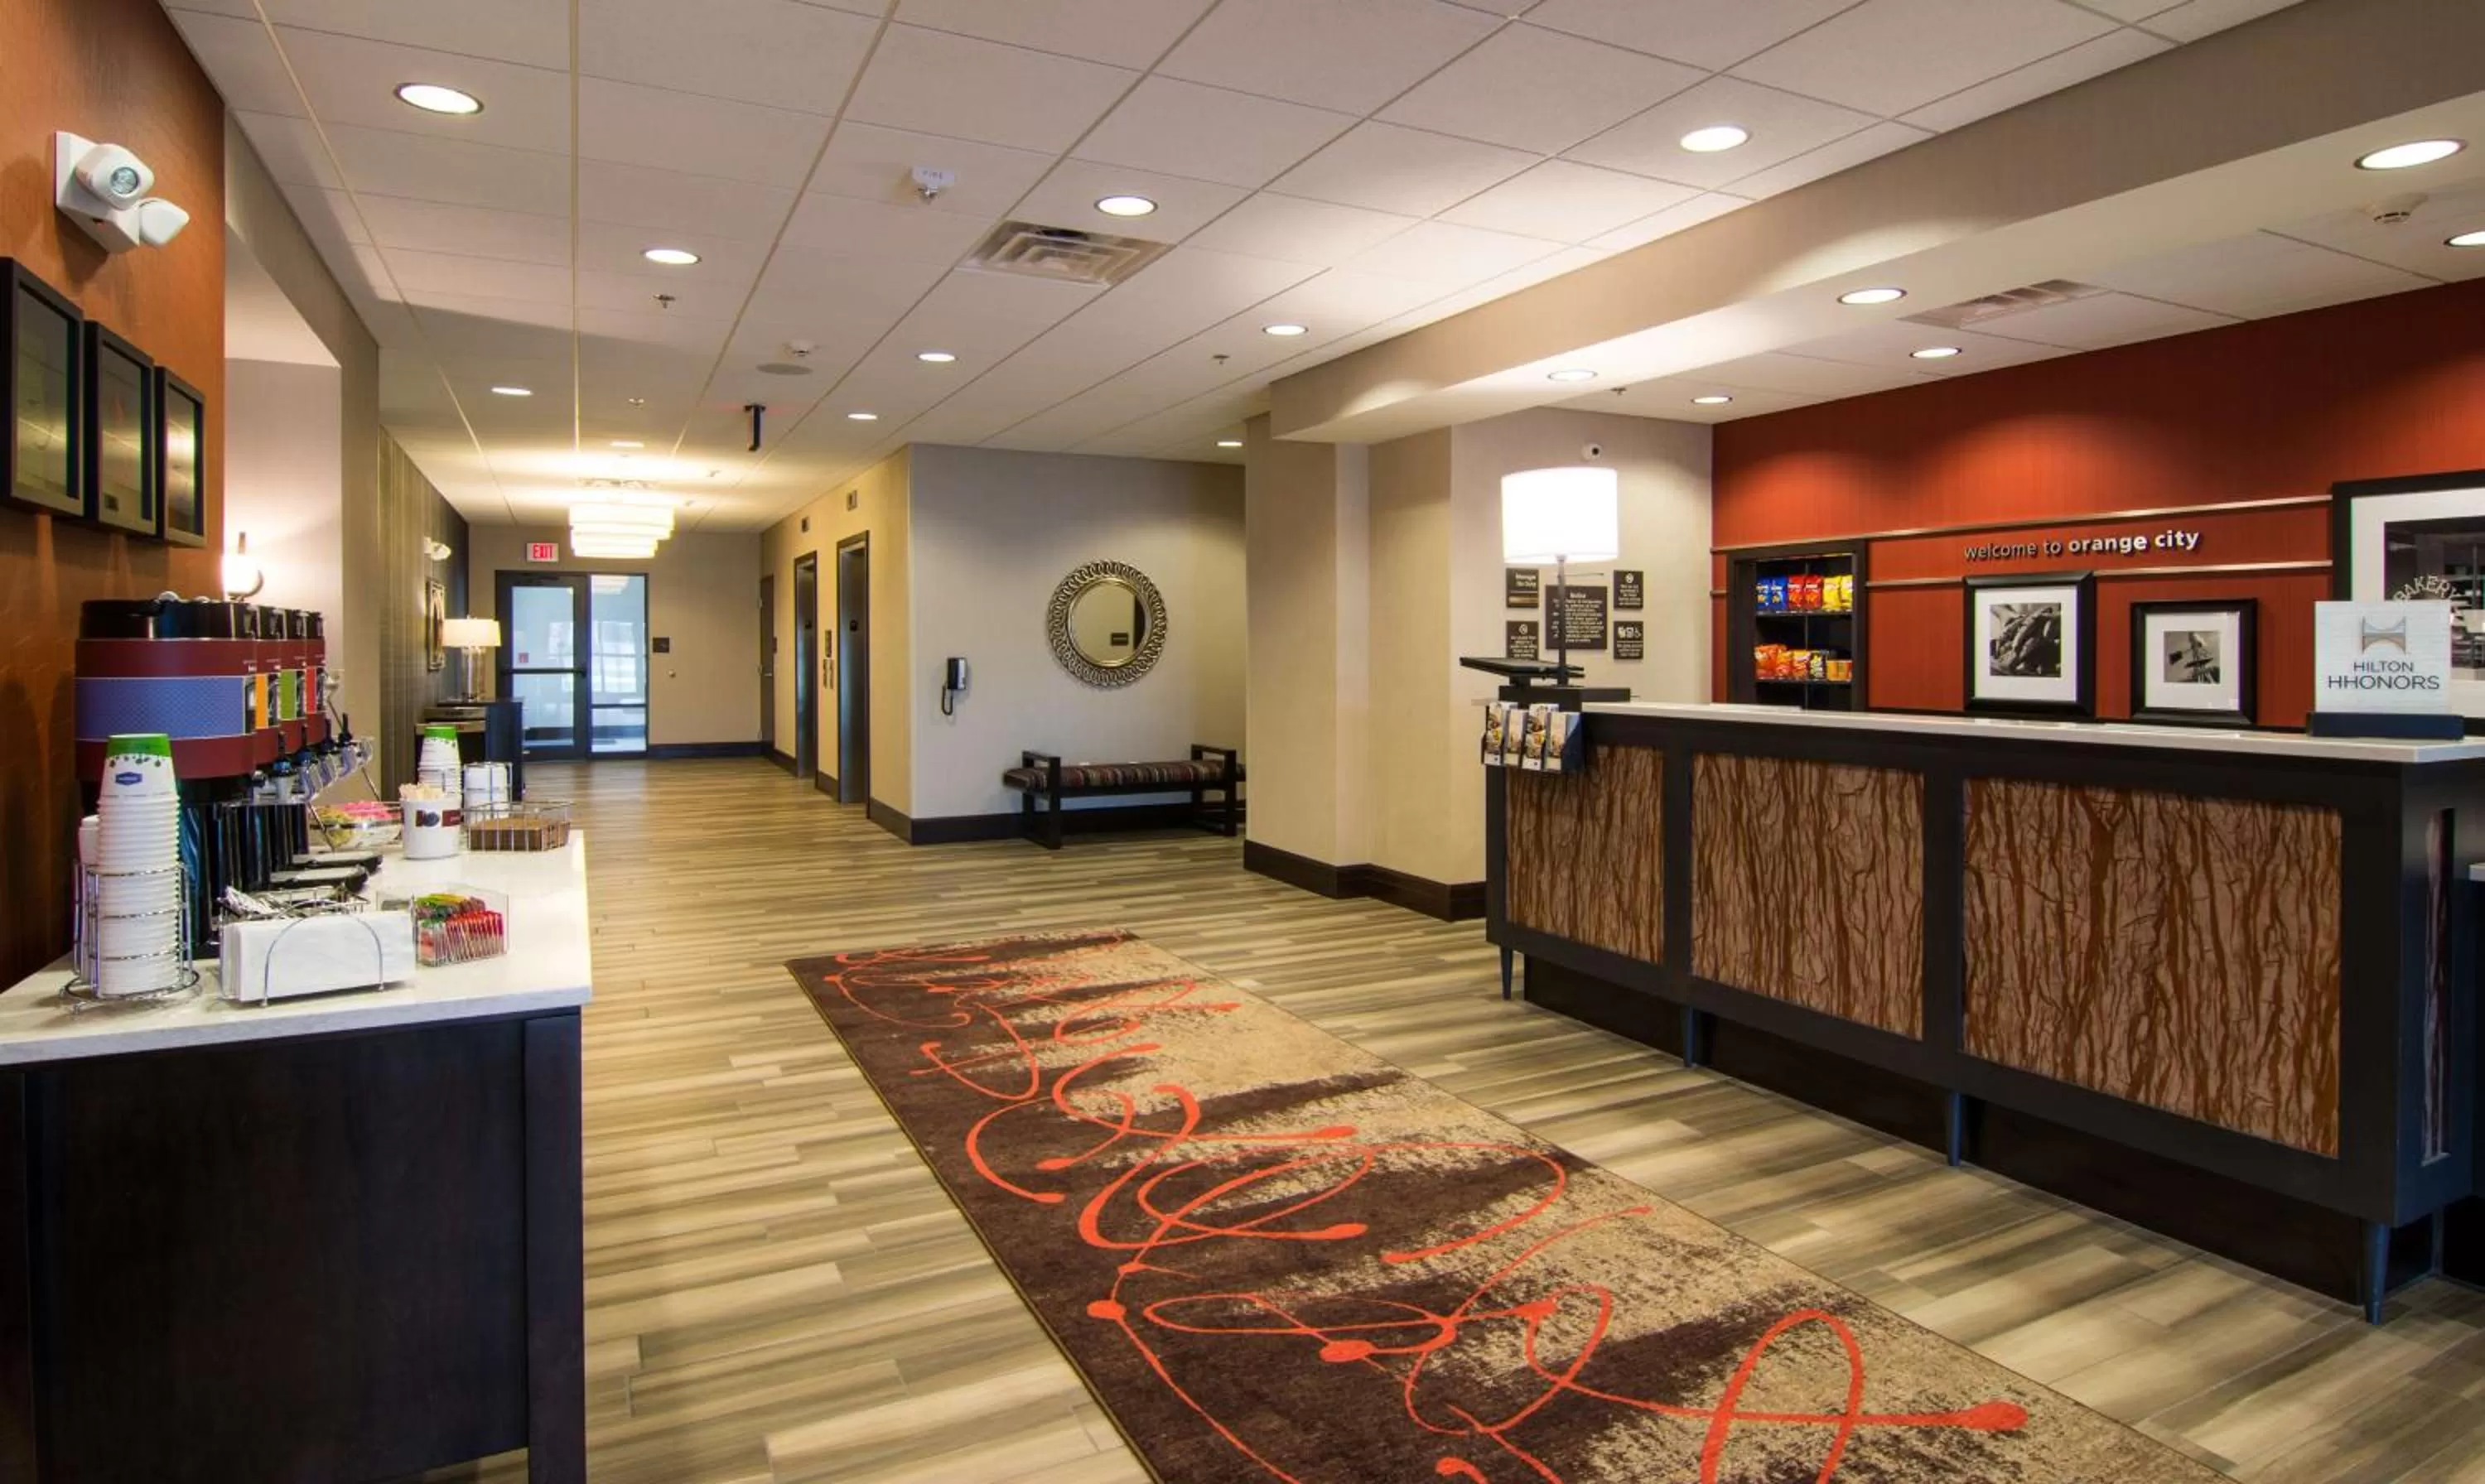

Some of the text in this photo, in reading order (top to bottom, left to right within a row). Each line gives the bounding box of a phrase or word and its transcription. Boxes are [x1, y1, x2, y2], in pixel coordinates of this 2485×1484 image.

[533, 543, 553, 559] EXIT
[1964, 530, 2199, 560] welcome to orange city
[2354, 660, 2414, 672] HILTON
[2328, 674, 2440, 690] HHONORS
